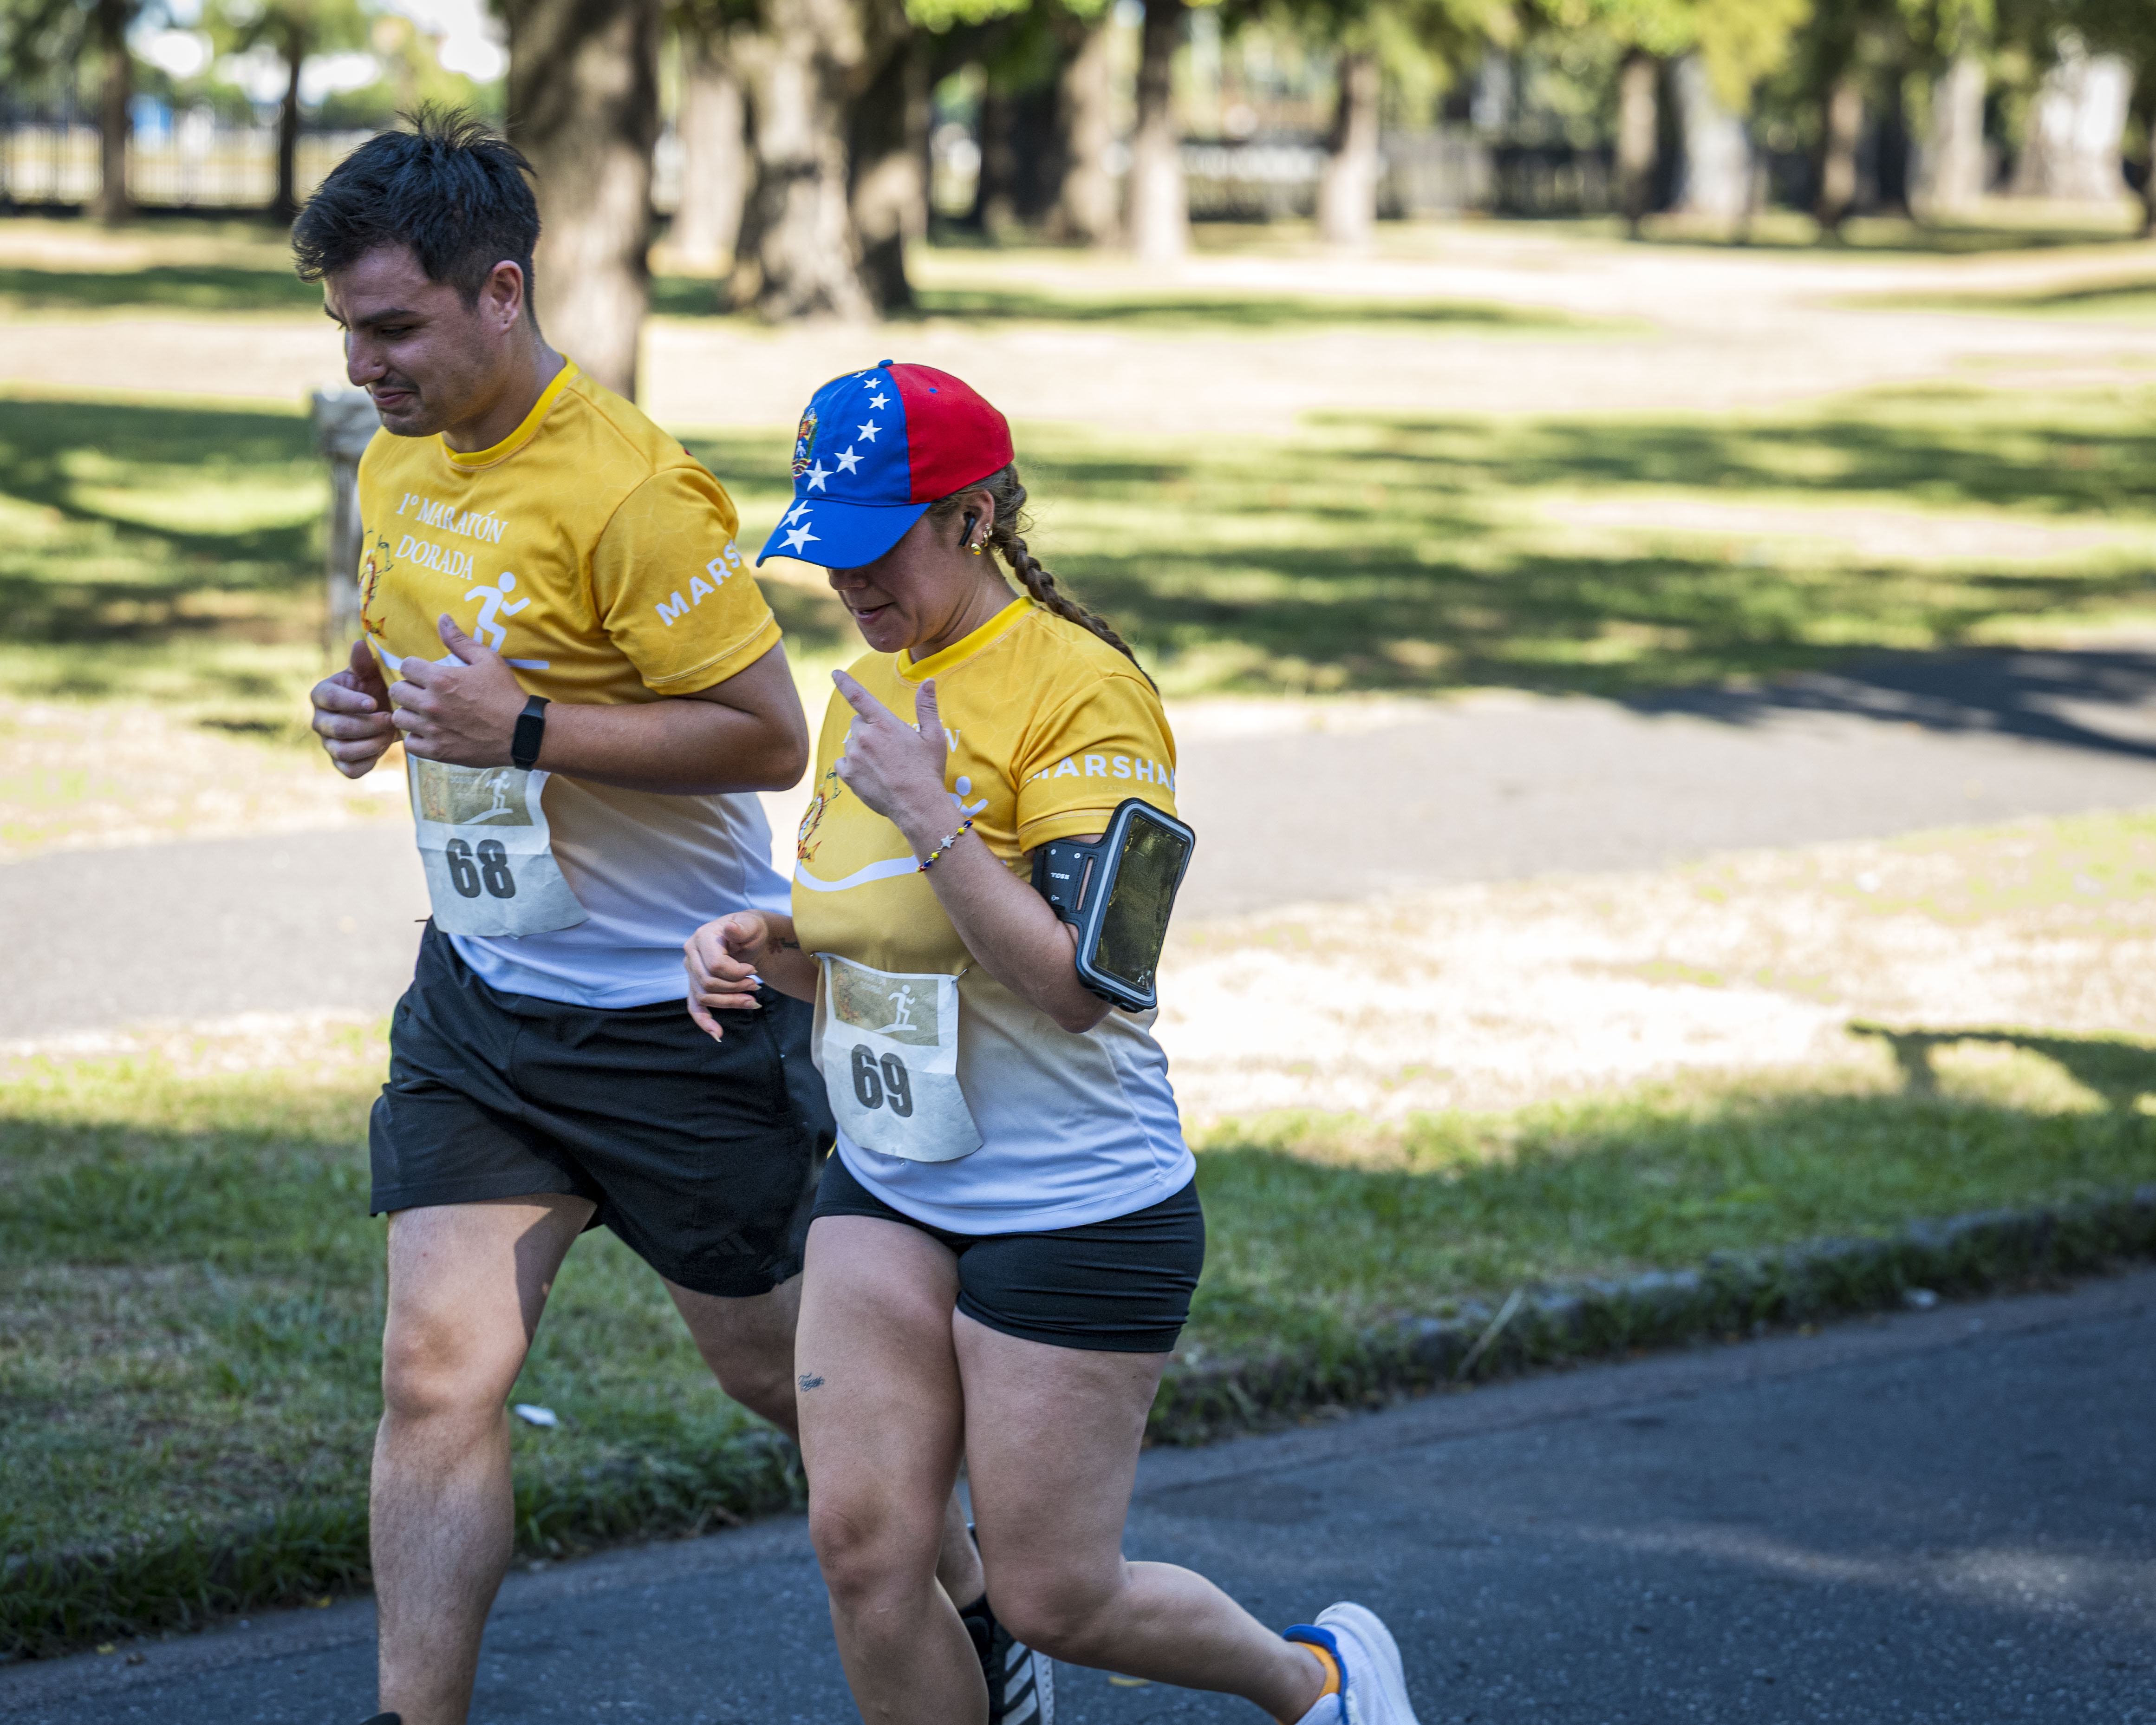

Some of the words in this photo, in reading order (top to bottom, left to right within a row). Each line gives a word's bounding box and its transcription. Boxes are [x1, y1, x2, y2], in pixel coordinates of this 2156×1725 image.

[415, 498, 509, 544] MARATÓN
[395, 534, 474, 581] DORADA
[654, 539, 742, 627] MARS
[446, 838, 516, 899] 68
[851, 1044, 913, 1118] 69
